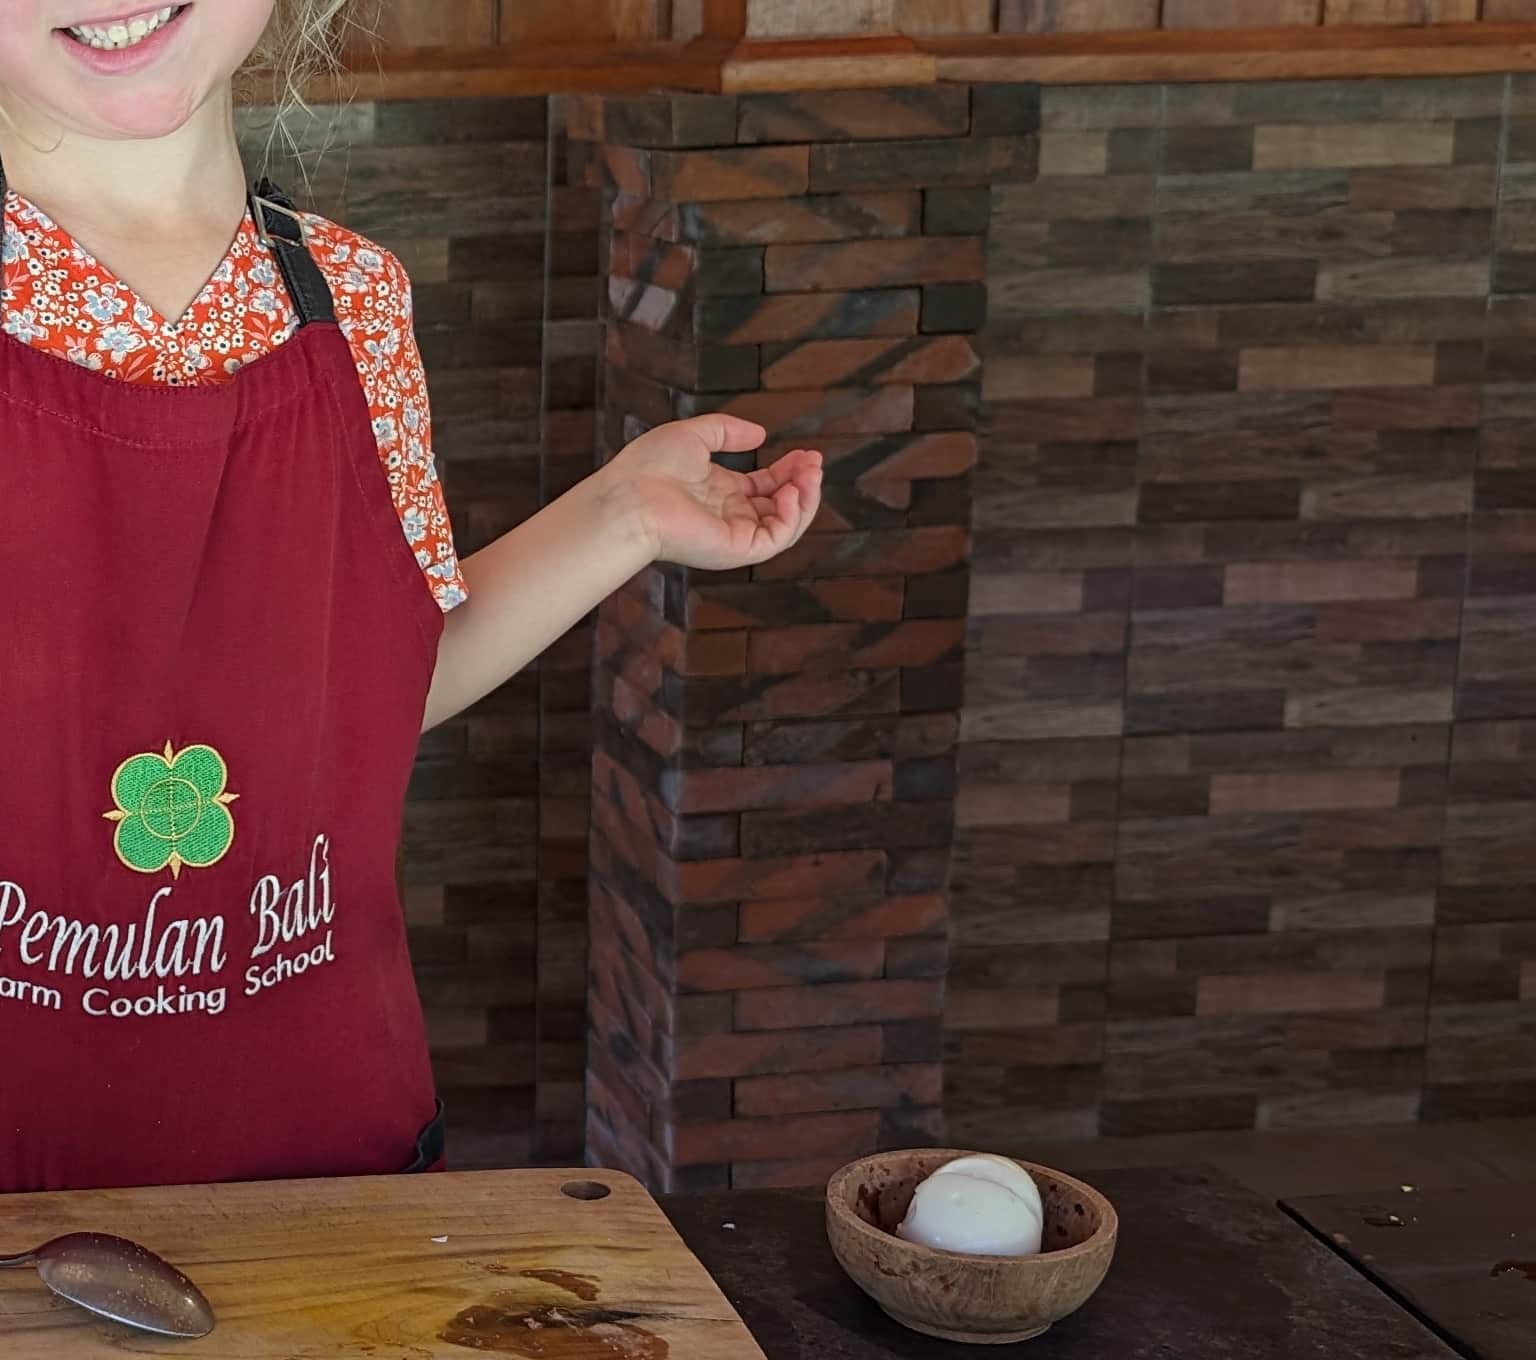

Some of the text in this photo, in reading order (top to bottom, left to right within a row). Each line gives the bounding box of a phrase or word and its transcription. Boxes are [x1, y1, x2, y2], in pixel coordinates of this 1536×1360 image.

[250, 833, 336, 959] Bali
[81, 986, 227, 1017] Cooking
[244, 930, 335, 996] School
